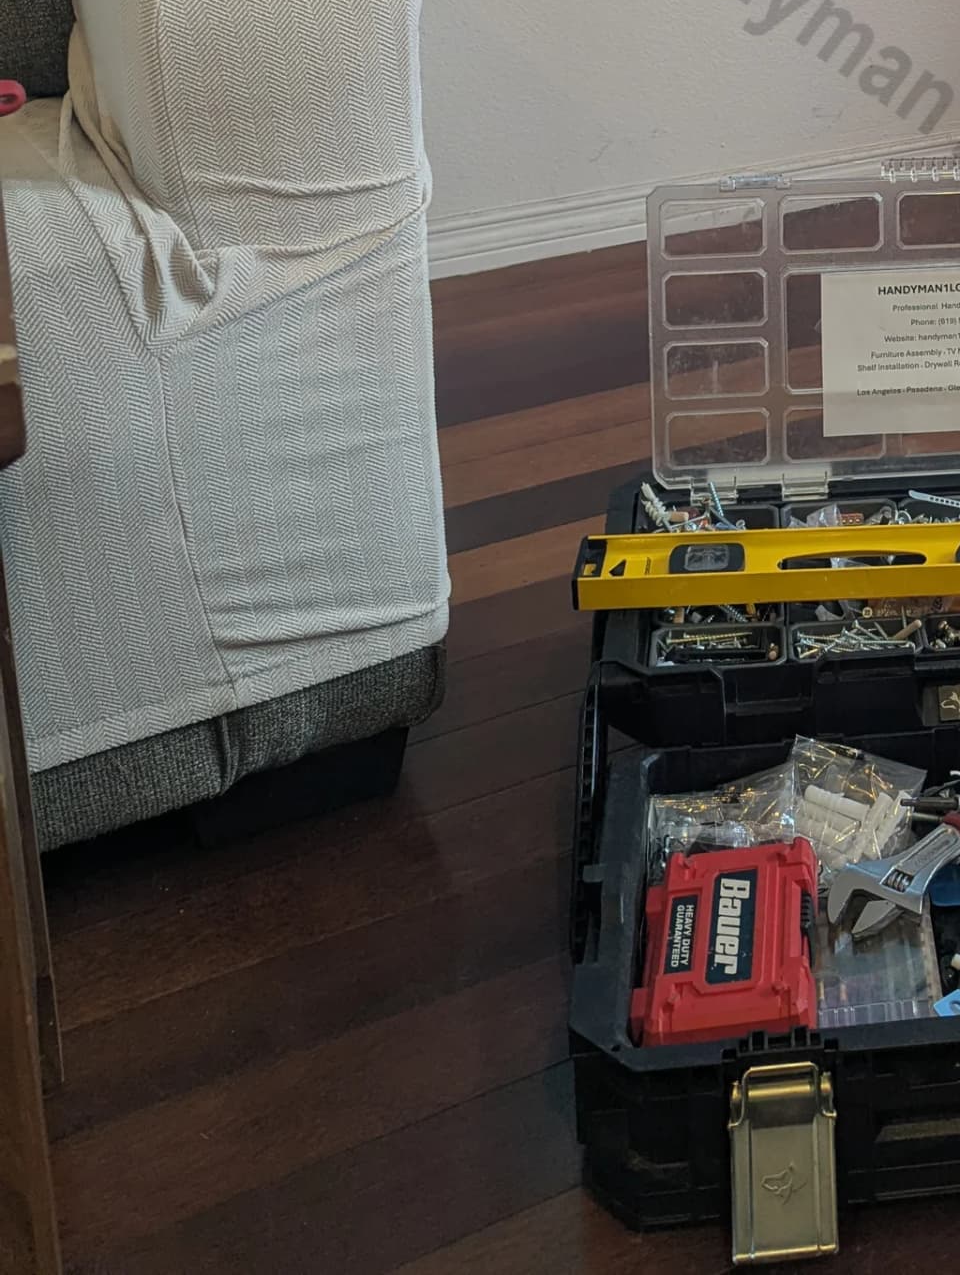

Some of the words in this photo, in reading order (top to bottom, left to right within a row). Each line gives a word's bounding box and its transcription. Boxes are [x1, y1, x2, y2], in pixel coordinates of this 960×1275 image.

[892, 303, 939, 312] Professional
[910, 318, 936, 326] Phone:
[884, 335, 917, 343] Website:
[870, 351, 905, 359] Furniture
[906, 349, 942, 358] Assembly
[946, 347, 957, 355] TV
[857, 364, 877, 372] Shelf
[878, 363, 920, 371] Installation
[924, 360, 953, 370] Drywall
[856, 389, 871, 397] Los
[871, 388, 902, 396] Angeles
[905, 385, 943, 393] Pasadena
[684, 904, 695, 936] HEAVY
[713, 877, 751, 975] Bauer
[671, 905, 685, 967] GUARANTEED
[681, 938, 691, 965] DUTY
